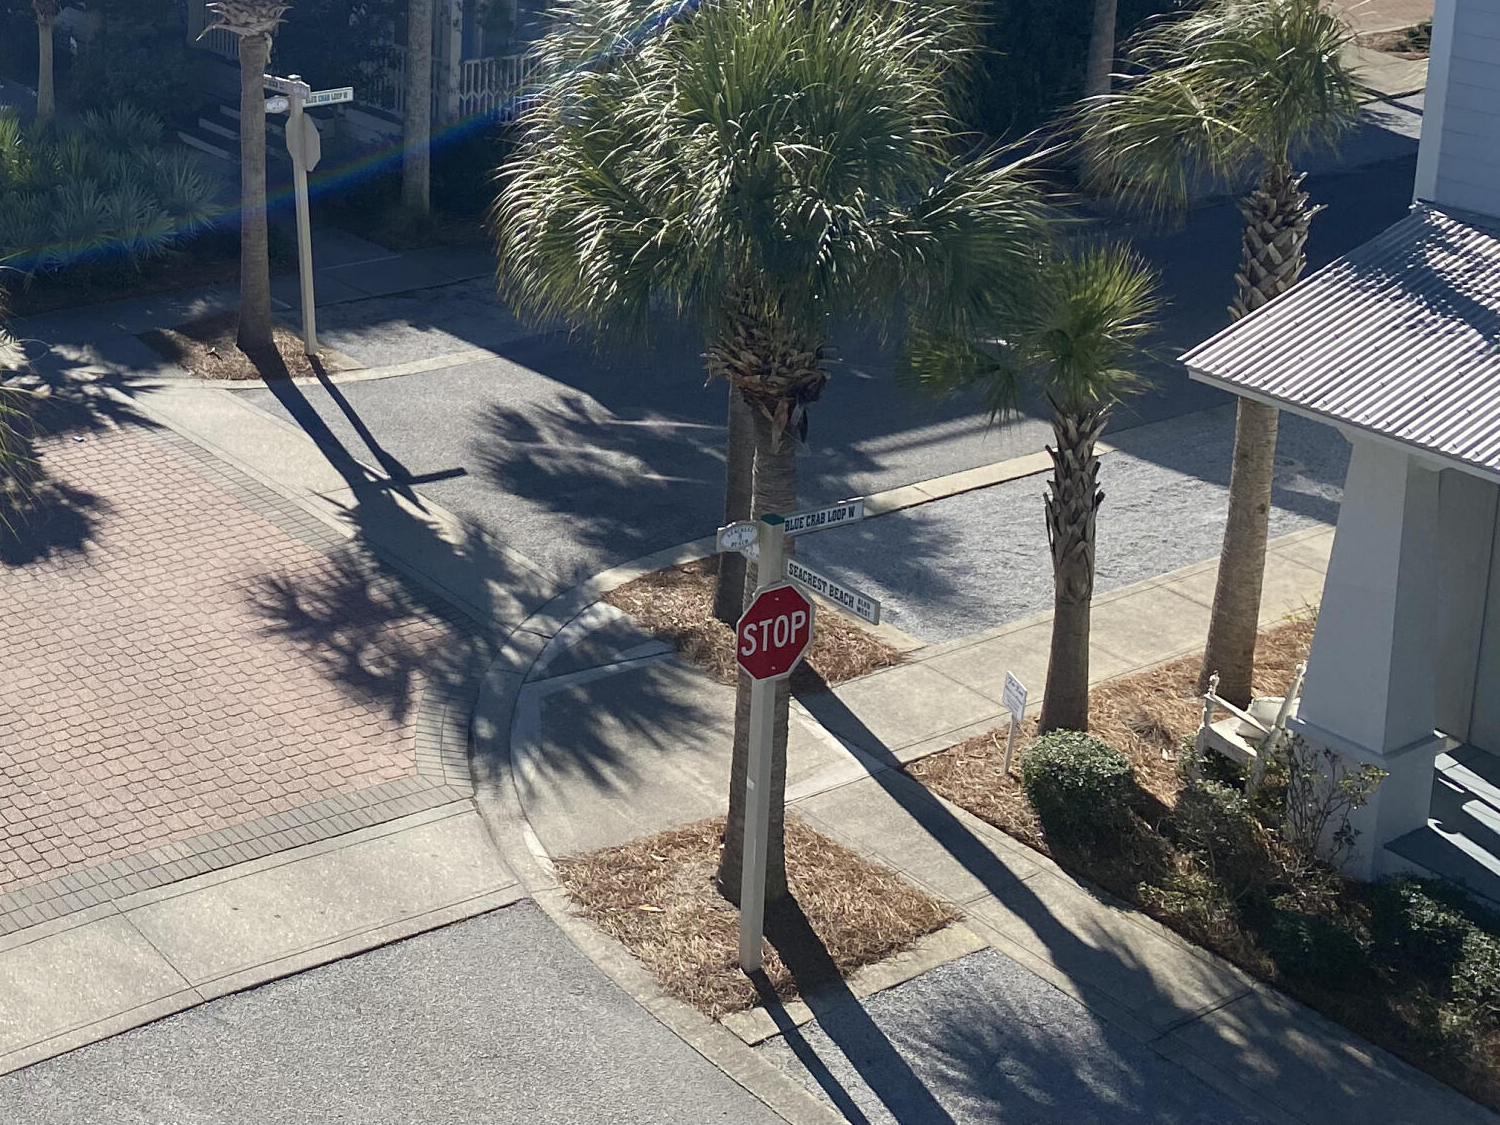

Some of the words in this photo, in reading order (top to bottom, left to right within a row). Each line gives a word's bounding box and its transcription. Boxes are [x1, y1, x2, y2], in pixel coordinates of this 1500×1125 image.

[784, 517, 805, 533] BLUE
[806, 512, 826, 527] CRAB
[827, 507, 847, 523] LOOP
[848, 505, 856, 519] W
[788, 562, 828, 593] SEACREST
[829, 583, 855, 609] BEACH
[740, 610, 806, 657] STOP
